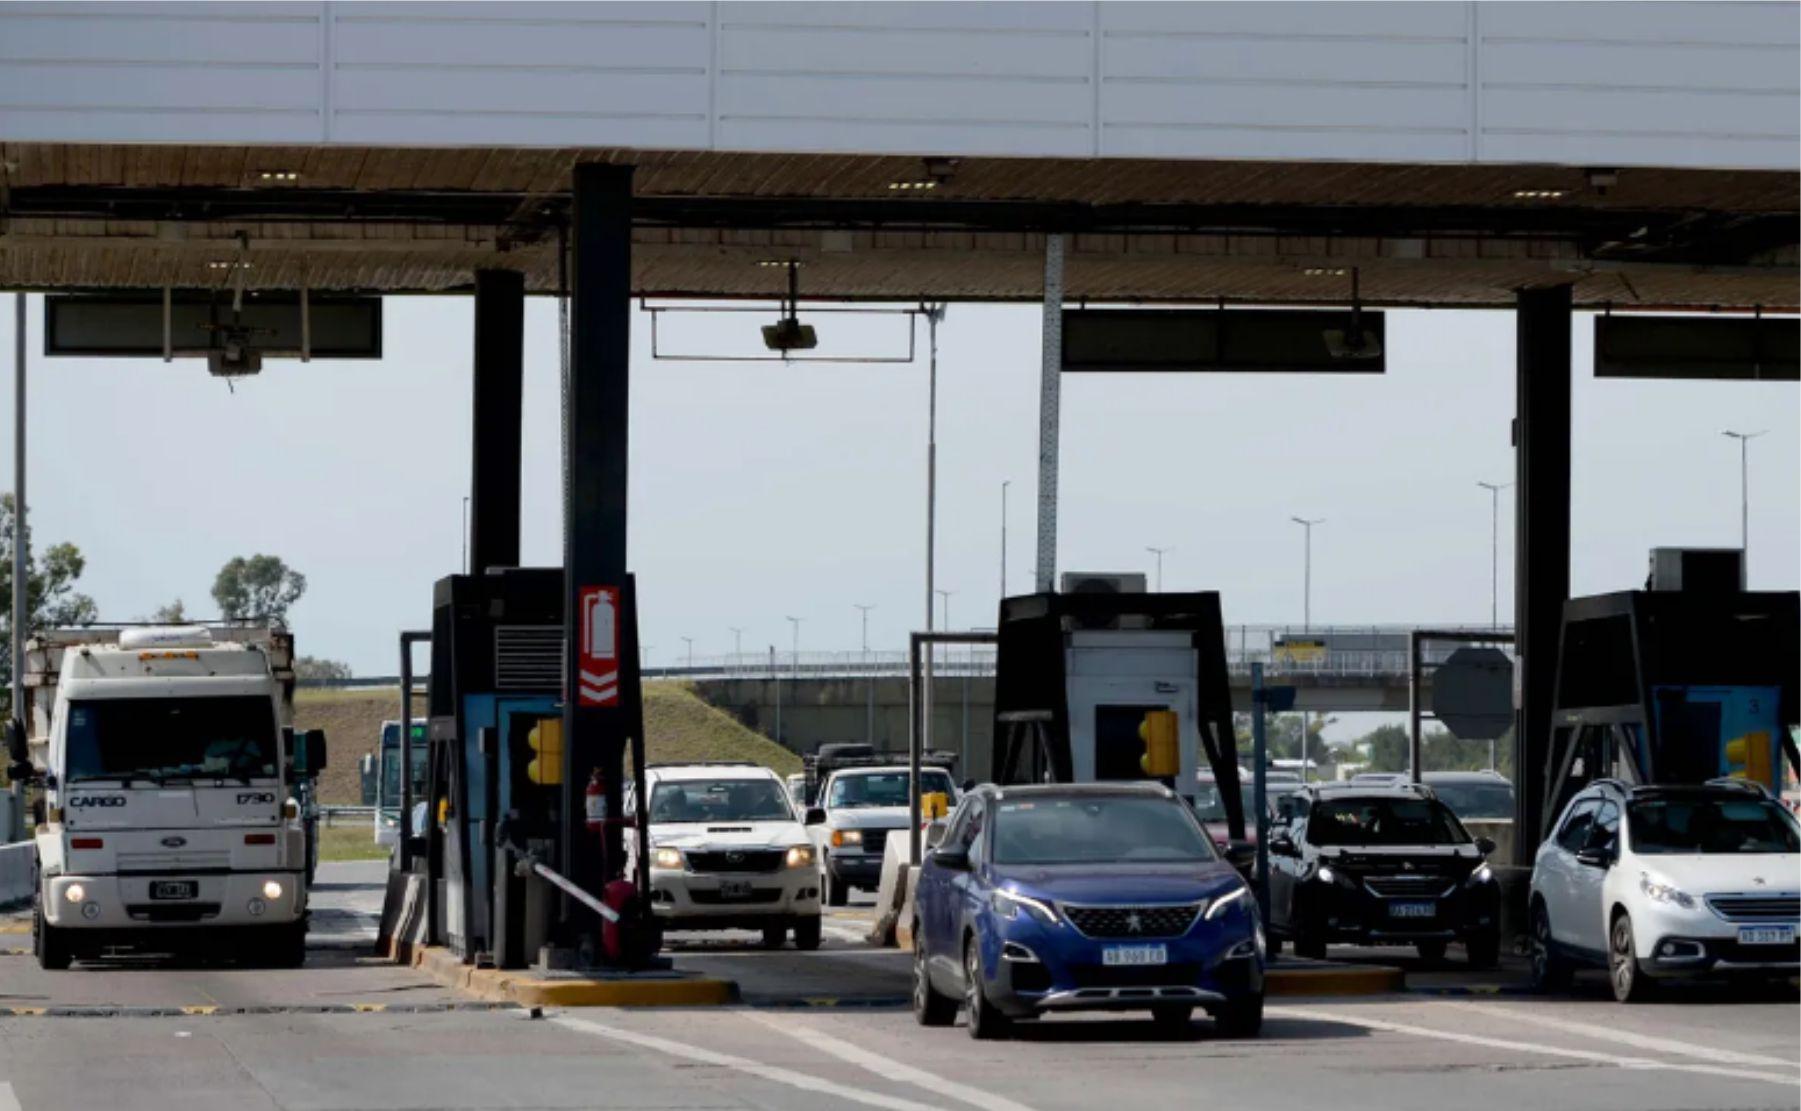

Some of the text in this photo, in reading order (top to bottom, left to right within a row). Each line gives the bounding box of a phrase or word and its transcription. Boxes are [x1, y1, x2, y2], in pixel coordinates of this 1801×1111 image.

[1748, 698, 1760, 714] 3
[69, 795, 127, 808] CARGO
[236, 792, 276, 805] 1730
